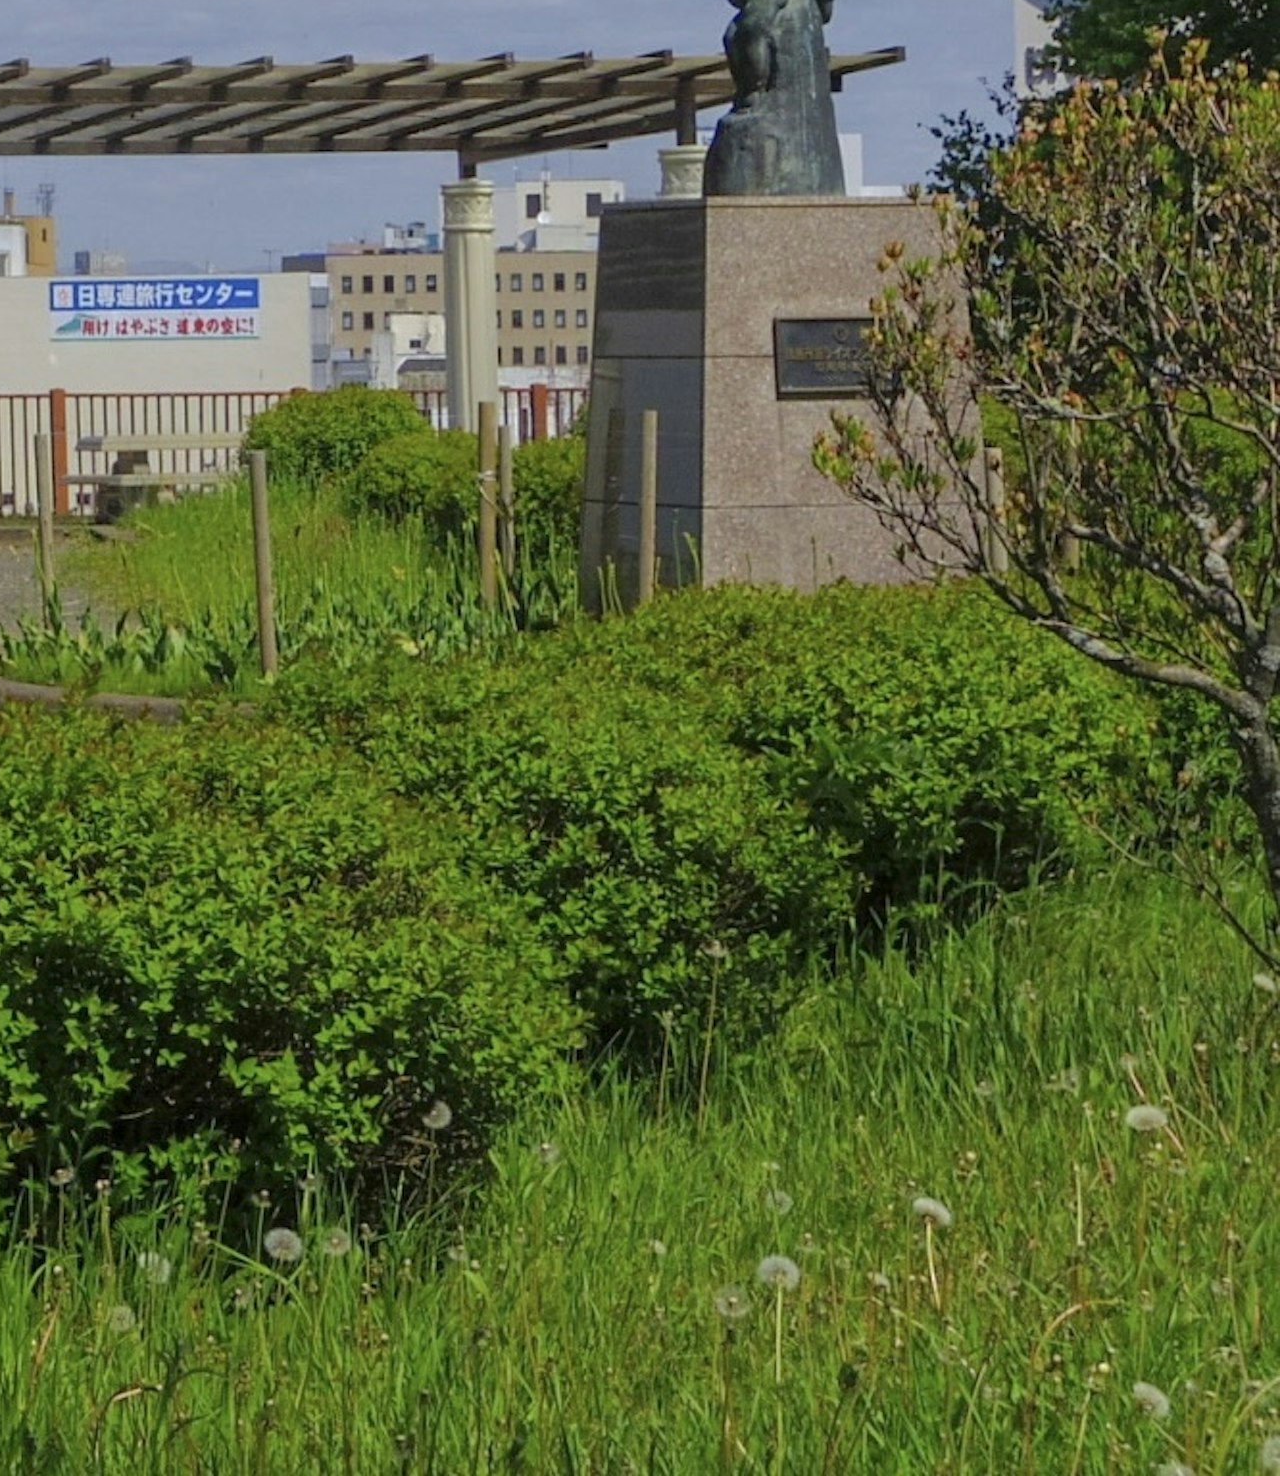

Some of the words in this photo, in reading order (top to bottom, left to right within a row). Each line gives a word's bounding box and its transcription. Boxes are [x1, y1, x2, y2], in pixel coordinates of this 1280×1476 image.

[77, 282, 254, 309] 日専連旅行センター
